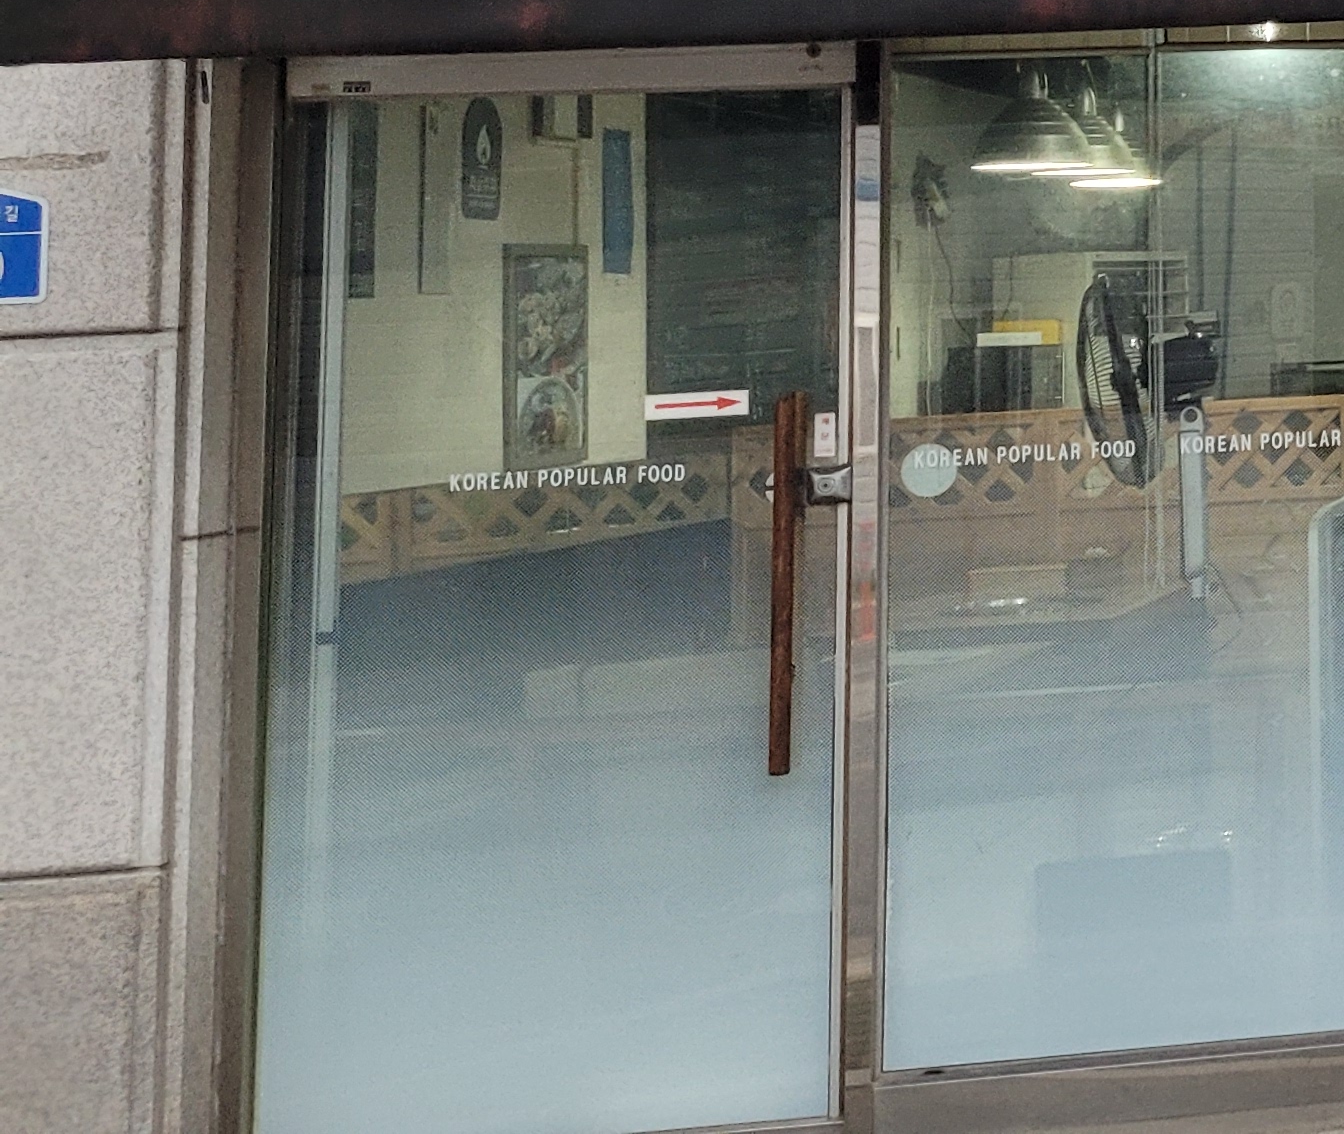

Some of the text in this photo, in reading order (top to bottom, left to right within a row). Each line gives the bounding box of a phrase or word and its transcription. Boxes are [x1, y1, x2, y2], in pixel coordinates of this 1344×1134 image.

[914, 440, 1136, 469] KOREAN POPULAR FOOD
[1180, 434, 1252, 454] KOREAN
[1260, 429, 1341, 450] POPULAR
[450, 464, 686, 492] KOREAN POPULAR FOOD
